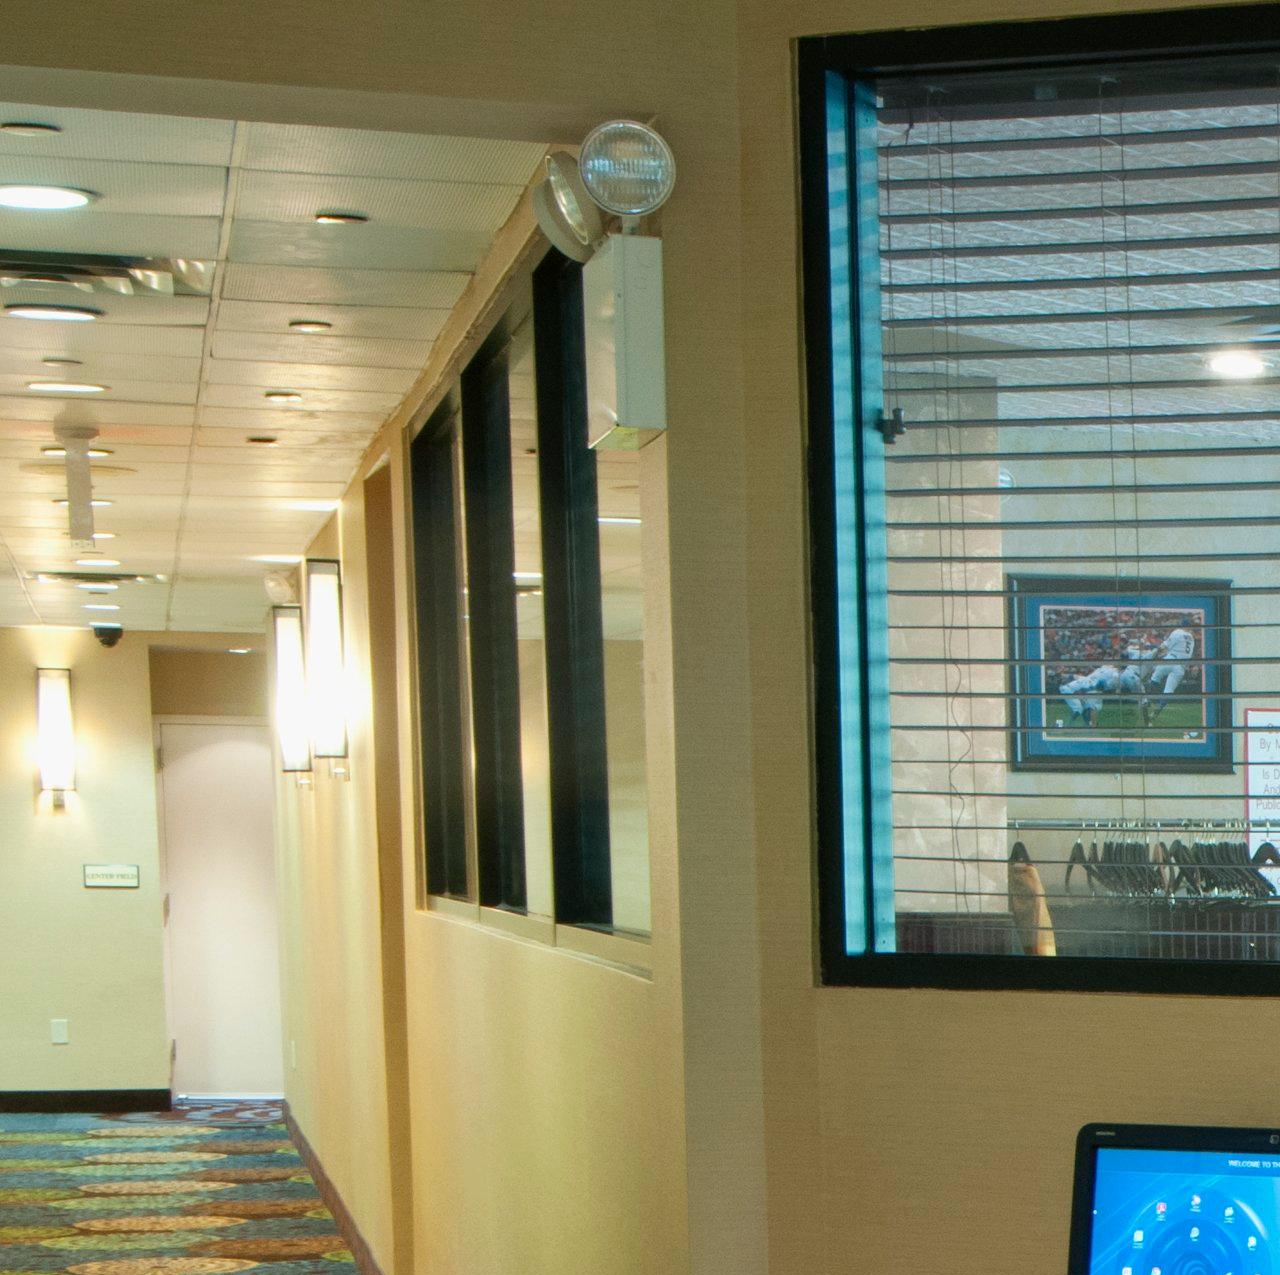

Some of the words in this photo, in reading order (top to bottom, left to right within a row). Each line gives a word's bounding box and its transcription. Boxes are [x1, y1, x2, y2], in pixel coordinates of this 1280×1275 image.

[1259, 738, 1271, 752] By
[1228, 1160, 1260, 1169] WELCOME
[1262, 1161, 1271, 1169] TO
